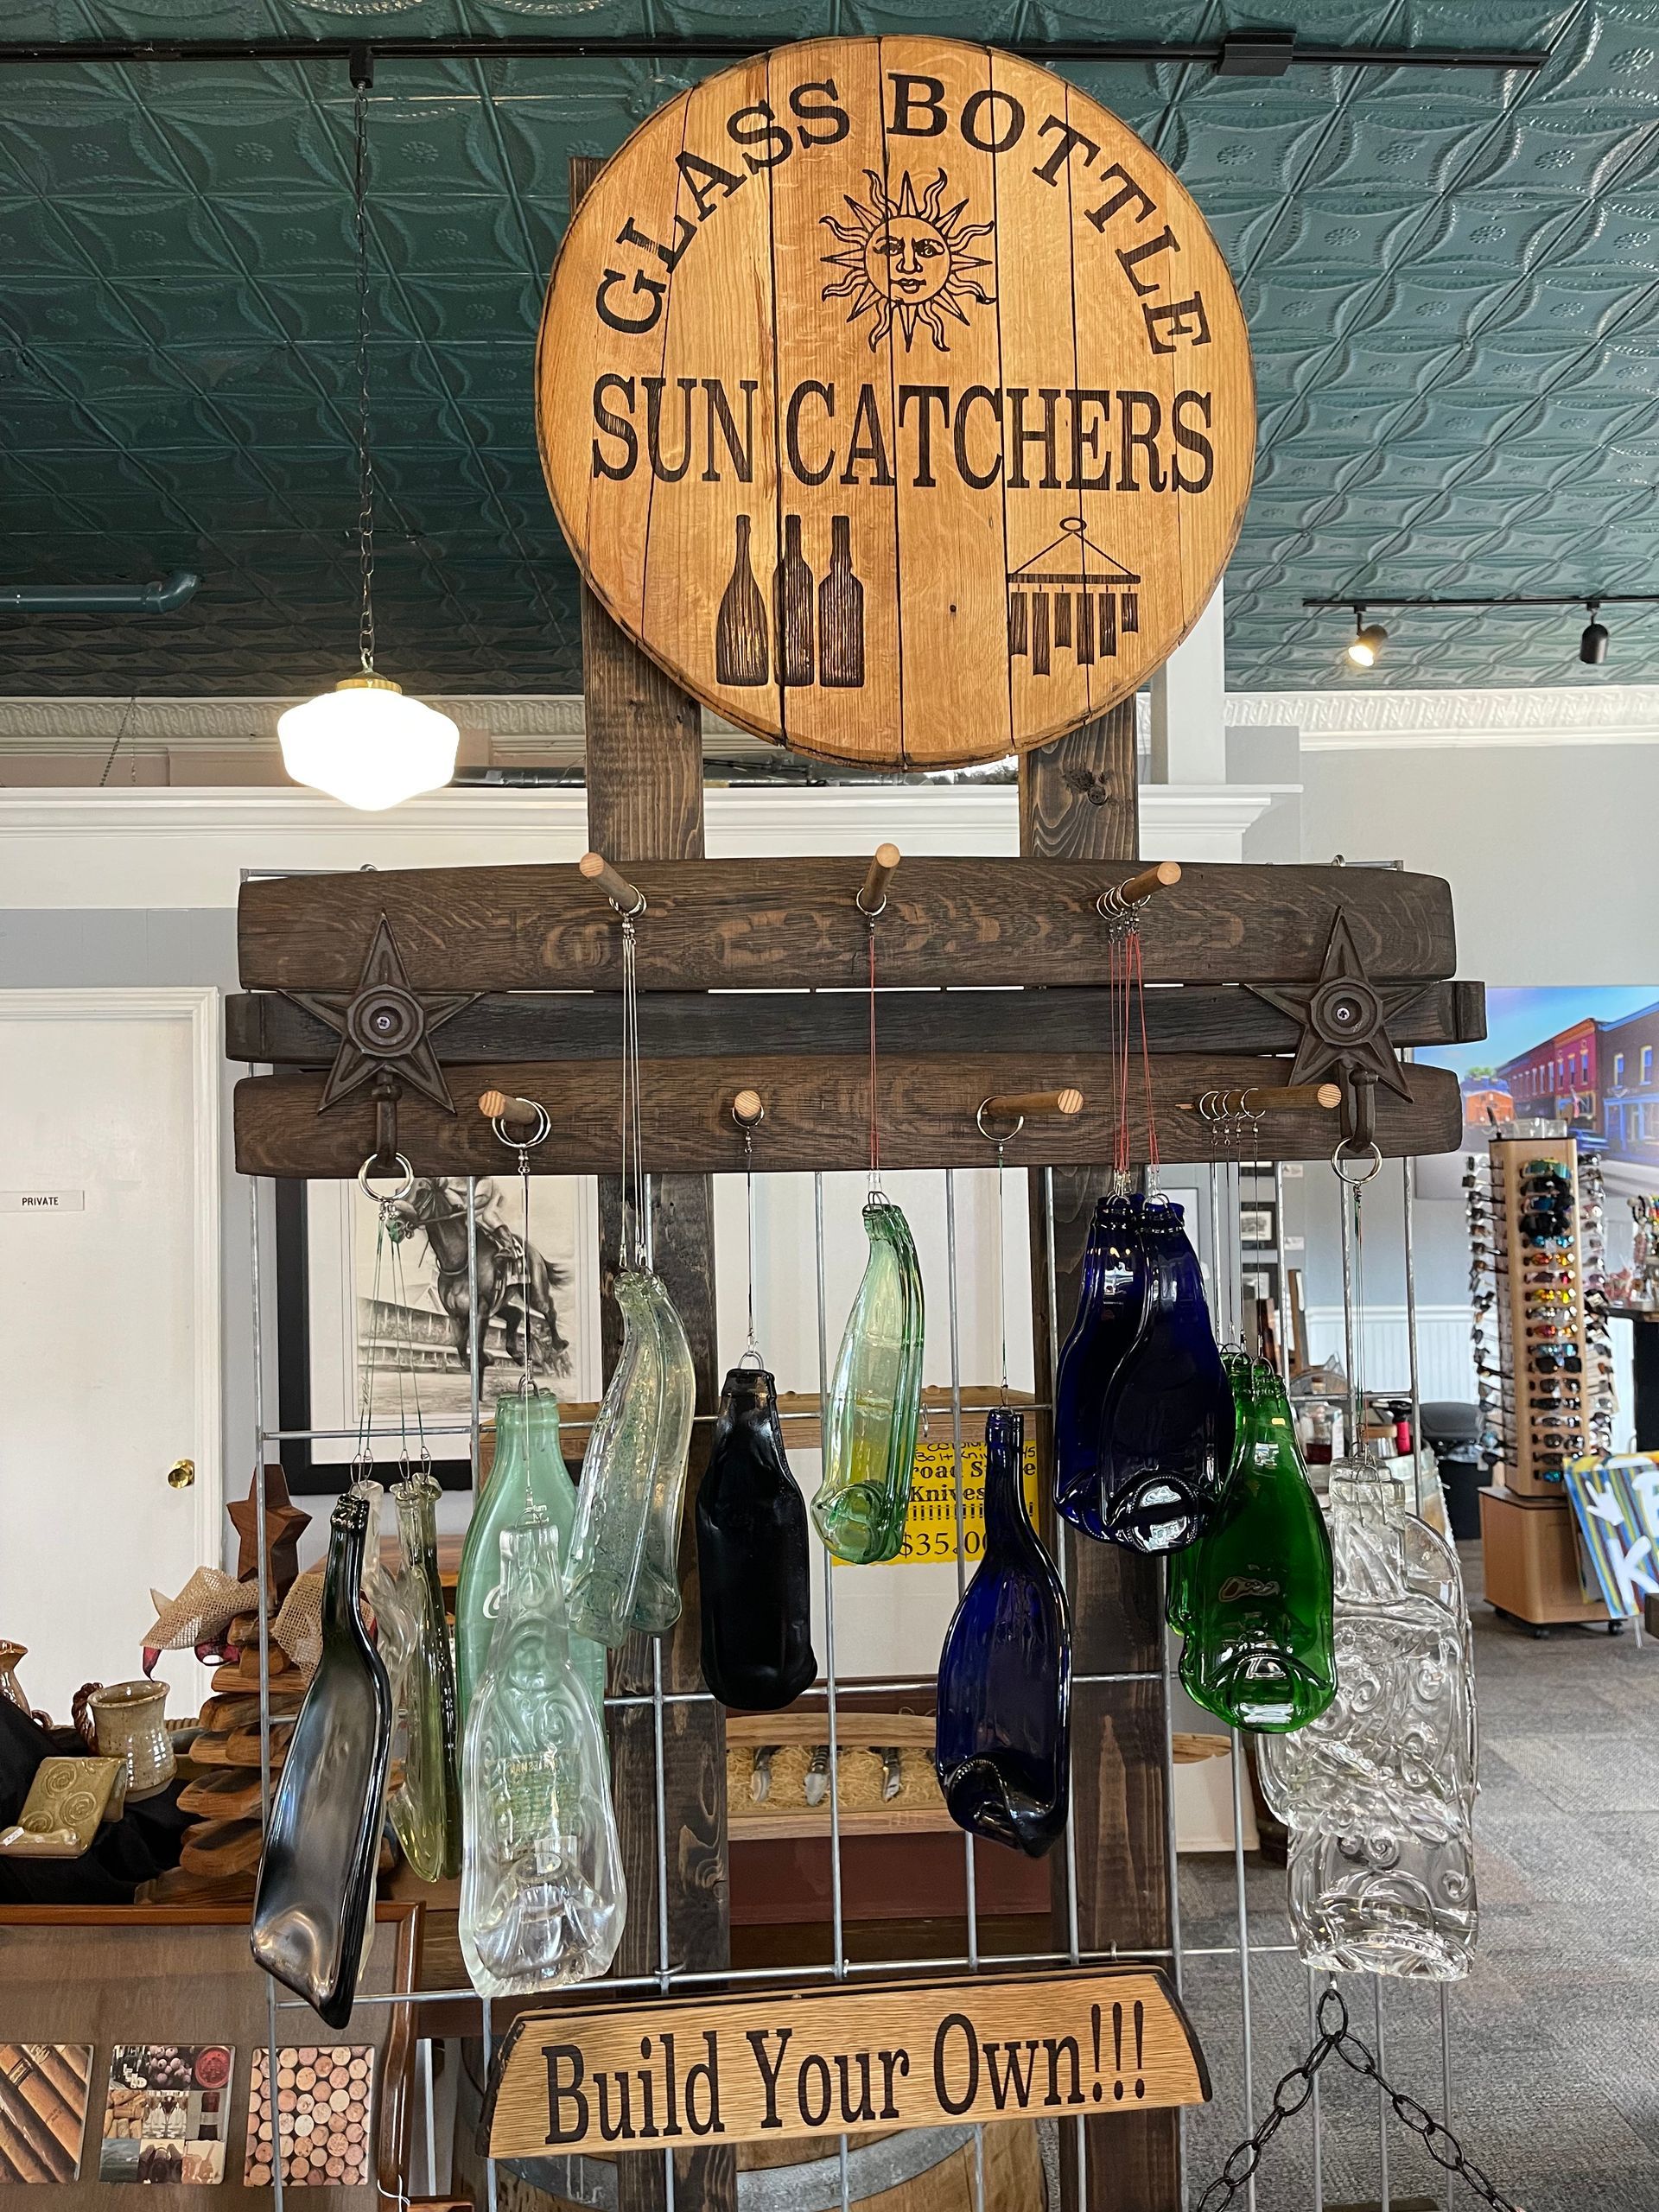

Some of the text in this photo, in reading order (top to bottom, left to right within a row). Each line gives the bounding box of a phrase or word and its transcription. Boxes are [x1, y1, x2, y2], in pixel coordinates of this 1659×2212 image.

[596, 73, 1211, 355] GLASS BOTTLE
[592, 373, 1211, 494] SUN CATCHERS
[22, 1197, 59, 1206] PRIVATE
[899, 1530, 988, 1559] $35.0
[541, 2000, 1145, 2145] Build Your Own!!!
